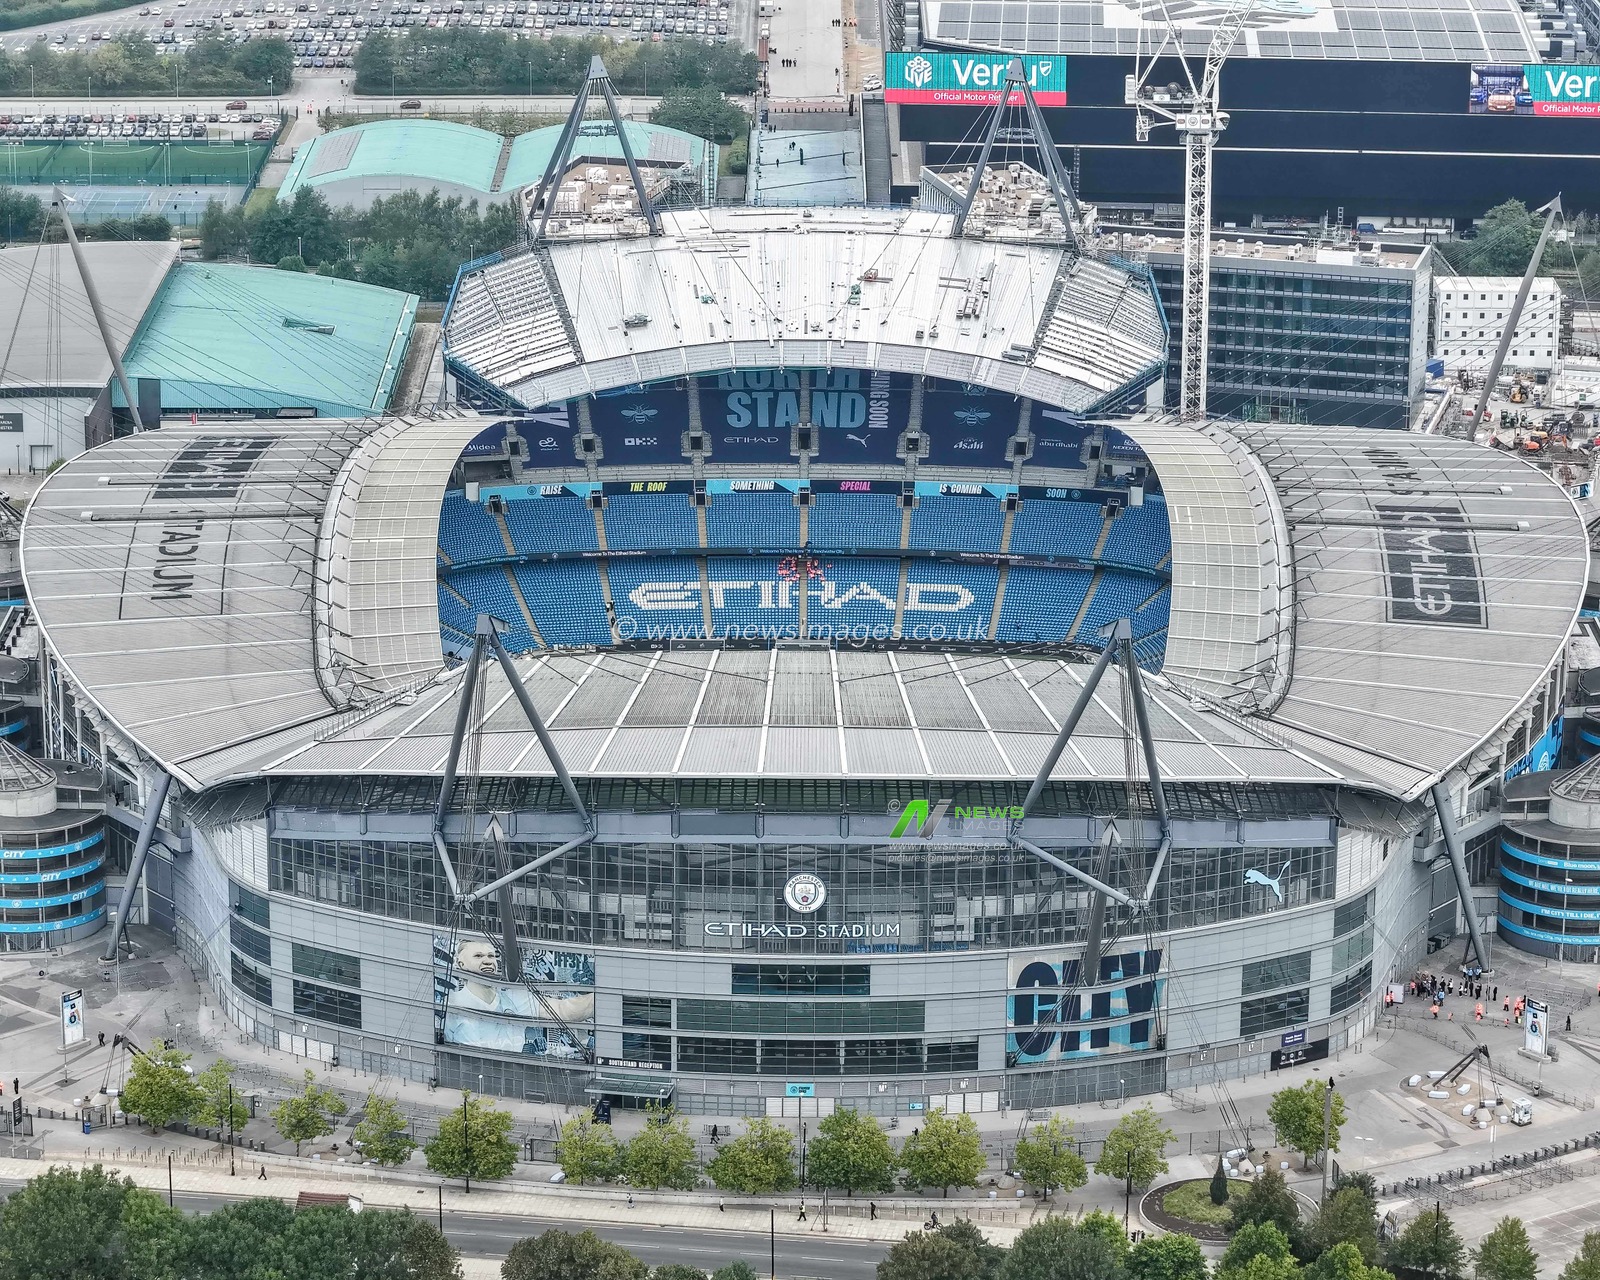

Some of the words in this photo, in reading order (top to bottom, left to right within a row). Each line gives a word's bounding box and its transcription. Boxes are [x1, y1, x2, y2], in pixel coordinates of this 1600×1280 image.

[952, 59, 1037, 87] Veru
[934, 92, 961, 101] Official
[964, 93, 986, 102] Motor
[1543, 105, 1570, 113] Official
[726, 391, 866, 428] STAND
[868, 400, 889, 429] SOON
[953, 440, 984, 450] Asahi
[540, 485, 562, 495] RAISE
[631, 483, 644, 491] THE
[647, 482, 668, 492] ROOF
[729, 481, 775, 490] SOMETHING
[840, 481, 871, 491] SPECIAL
[939, 483, 948, 493] IS
[950, 484, 983, 494] COMING
[1045, 488, 1068, 499] SOON
[629, 581, 975, 613] ETIHAD
[4, 850, 25, 858] CITY
[41, 872, 62, 881] CITY
[788, 875, 822, 889] MANCHESTER
[72, 889, 89, 901] CITY
[704, 922, 807, 937] ETIHAD
[817, 923, 901, 938] STADIUM
[609, 1059, 623, 1067] SOUTH
